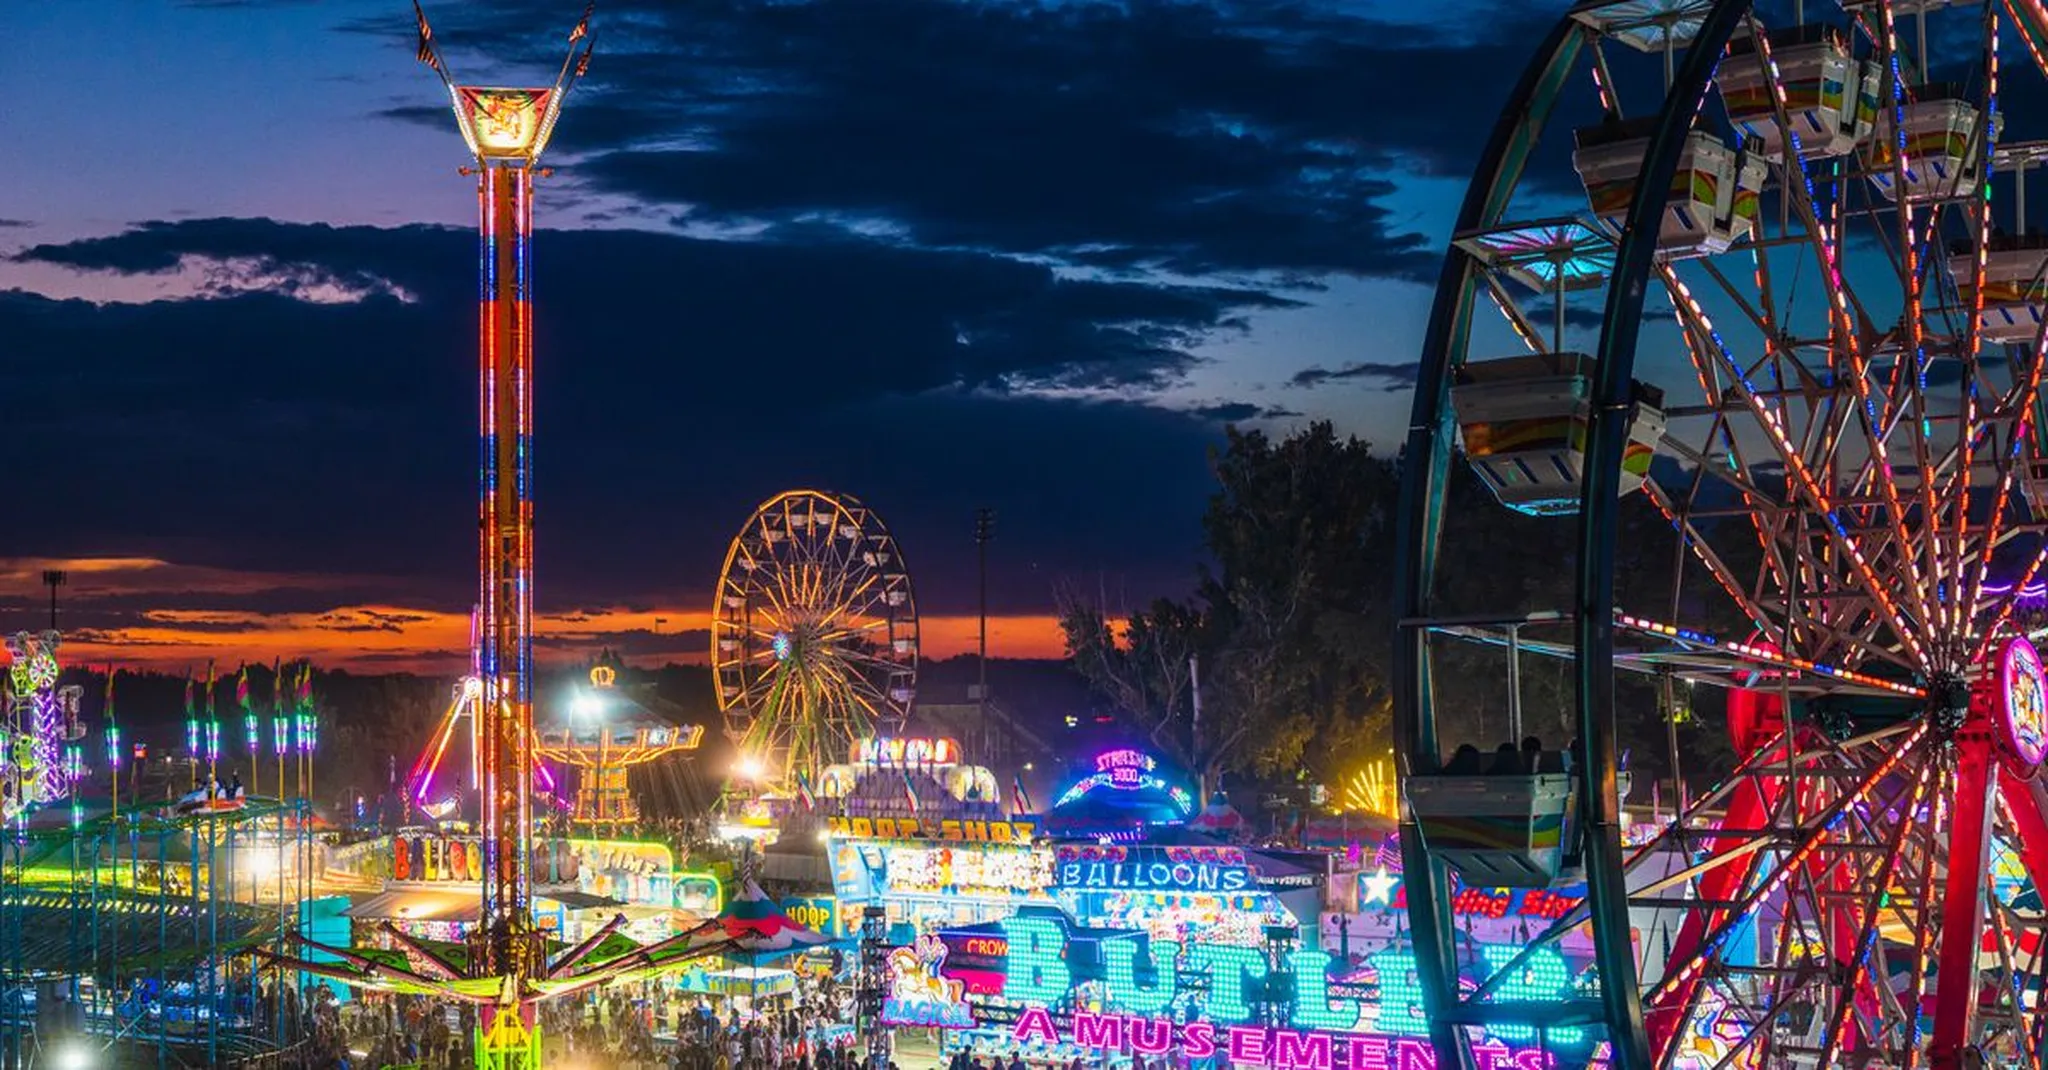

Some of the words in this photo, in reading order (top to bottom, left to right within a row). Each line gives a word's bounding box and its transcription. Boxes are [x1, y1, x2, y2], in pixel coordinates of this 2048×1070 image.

[1113, 767, 1138, 783] 3000
[941, 820, 1035, 844] SHOT
[603, 849, 660, 878] TIME
[1063, 863, 1246, 890] BALLOONS
[786, 905, 830, 926] HOOP
[1001, 916, 1584, 1043] BUTLER
[883, 998, 976, 1028] MAGICAL
